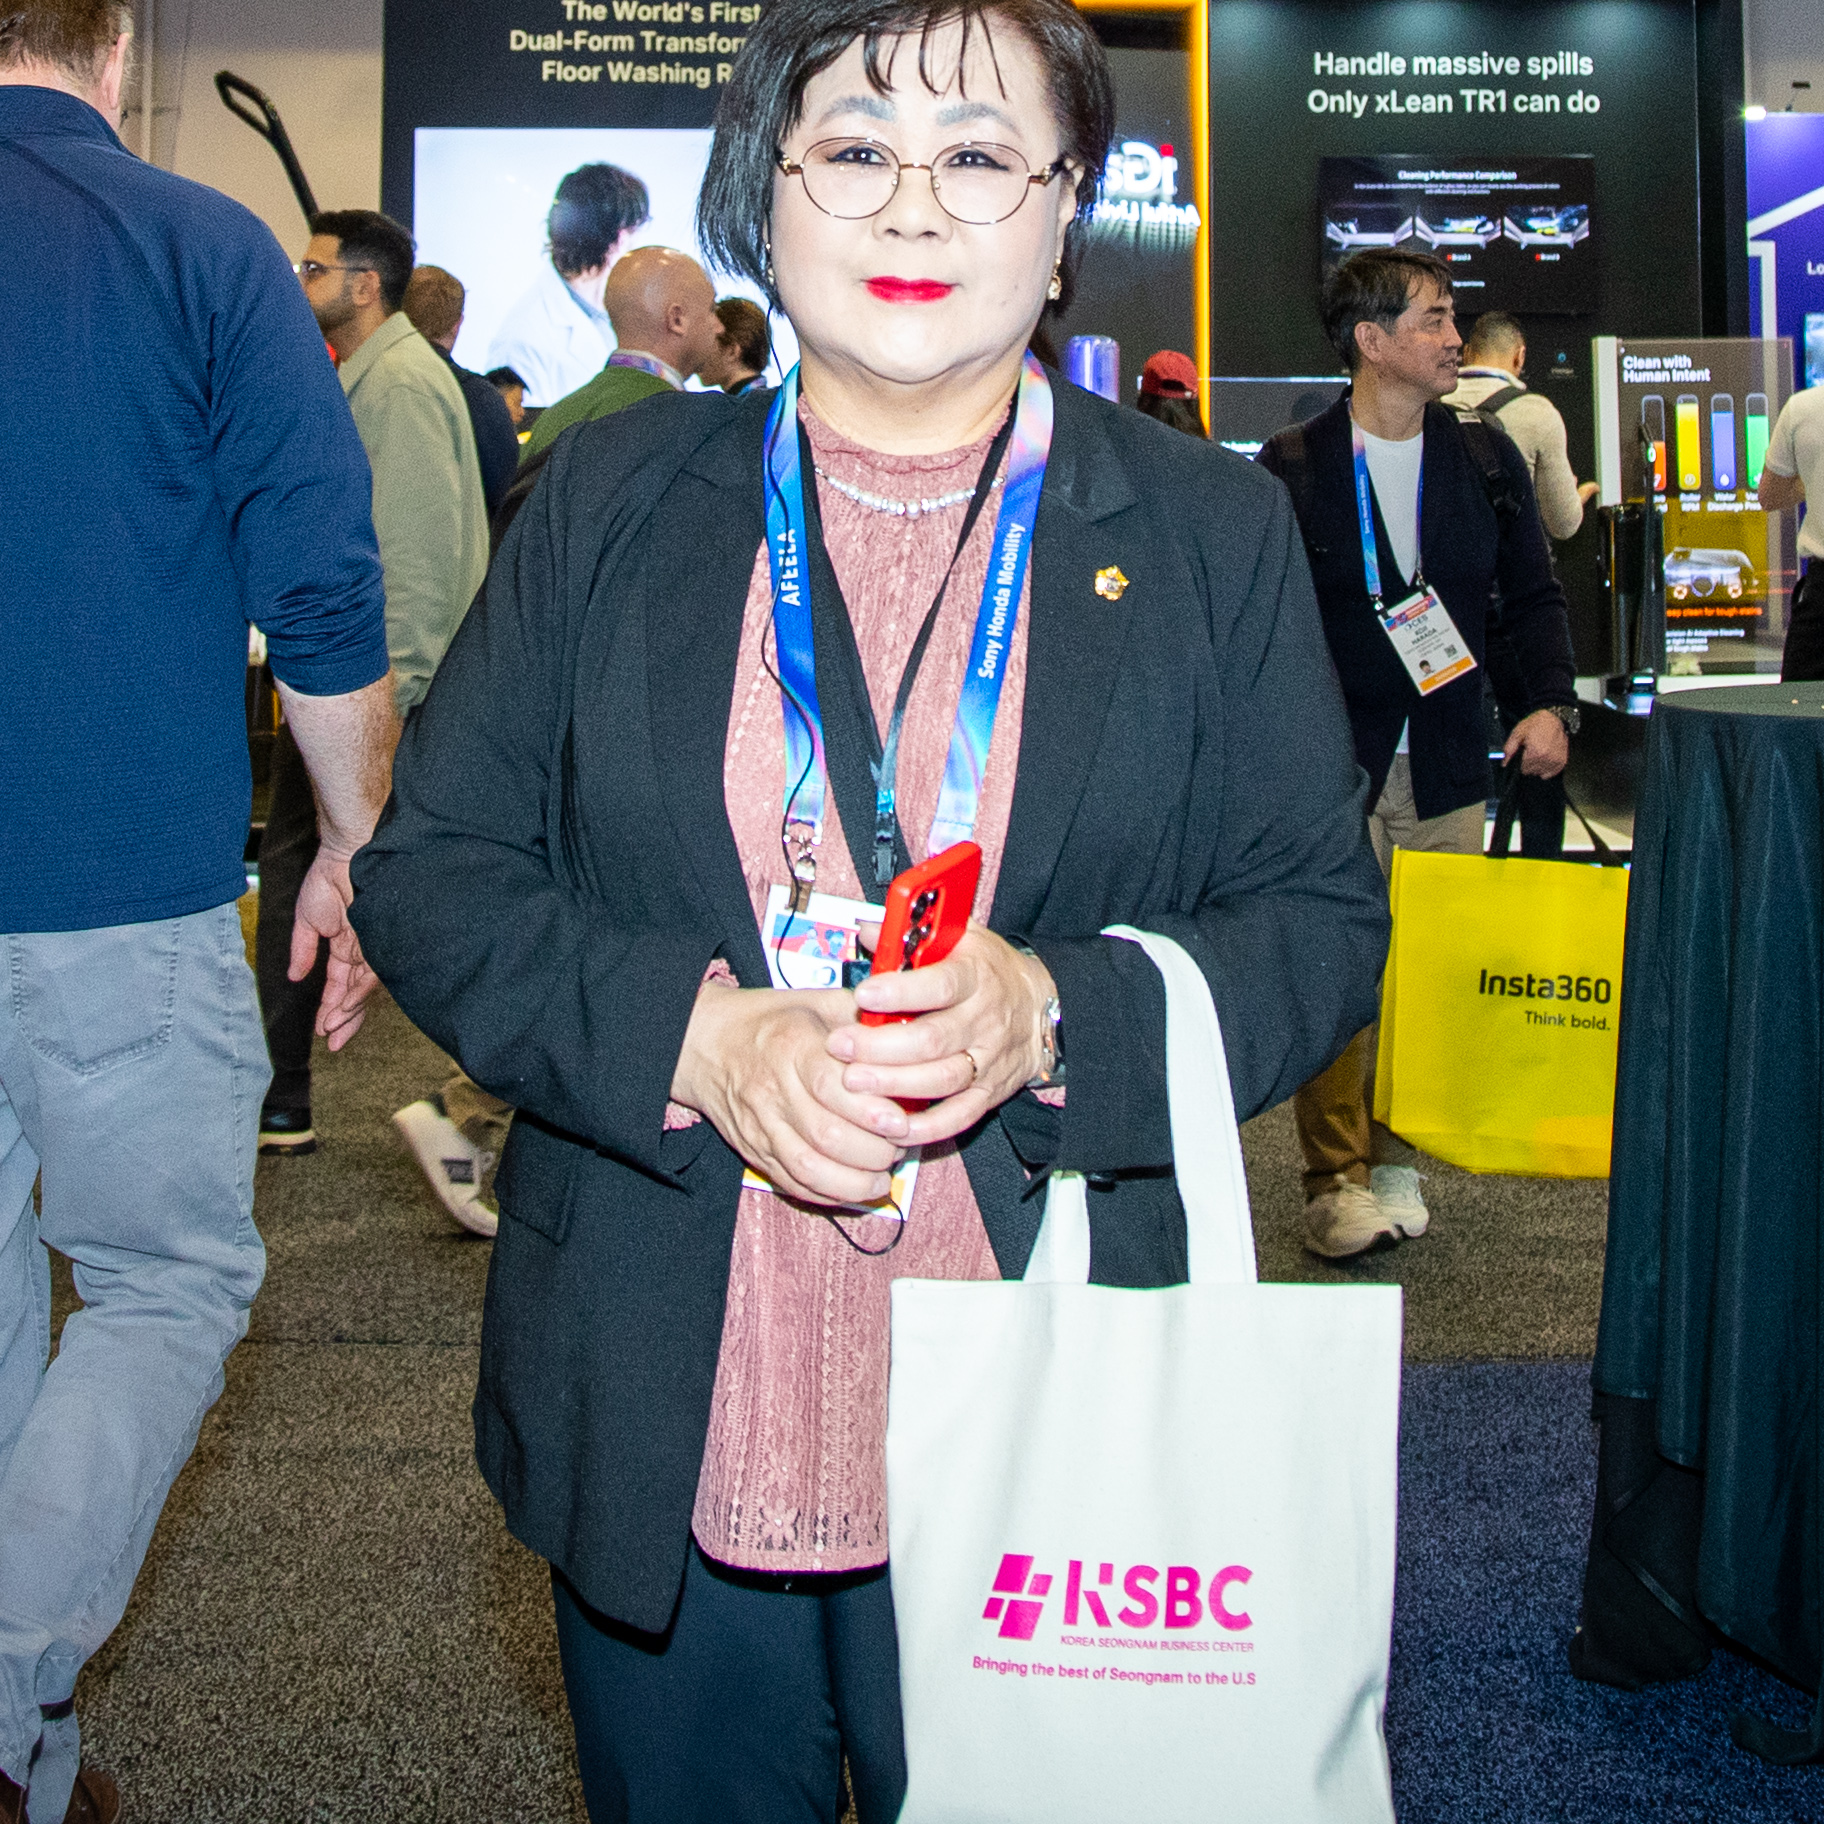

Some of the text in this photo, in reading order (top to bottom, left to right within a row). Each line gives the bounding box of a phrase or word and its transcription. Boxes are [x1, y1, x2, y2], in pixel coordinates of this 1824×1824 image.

[611, 0, 705, 24] World's
[709, 0, 762, 24] First
[508, 29, 635, 52] Dual-Form
[541, 60, 603, 83] Floor
[606, 60, 712, 90] Washing
[1313, 50, 1594, 81] Handle massive spills
[1306, 88, 1601, 119] Only xLean TR1 can do
[1622, 354, 1692, 370] Clean with
[1622, 367, 1711, 384] Human Intent
[977, 522, 1027, 680] Sony Honda Mobility
[1479, 968, 1612, 1005] Insta360
[1524, 1010, 1611, 1032] Think bold.
[1063, 1558, 1255, 1632] KSBC
[1060, 1634, 1255, 1653] KOREA SEONGNAM BUSINESS CENTER
[972, 1655, 1028, 1677] Bringing
[1031, 1662, 1055, 1677] the
[1058, 1663, 1089, 1680] best
[1092, 1666, 1108, 1680] of
[1109, 1667, 1184, 1686] Seongnam
[1187, 1672, 1202, 1685] to
[1205, 1671, 1228, 1685] the
